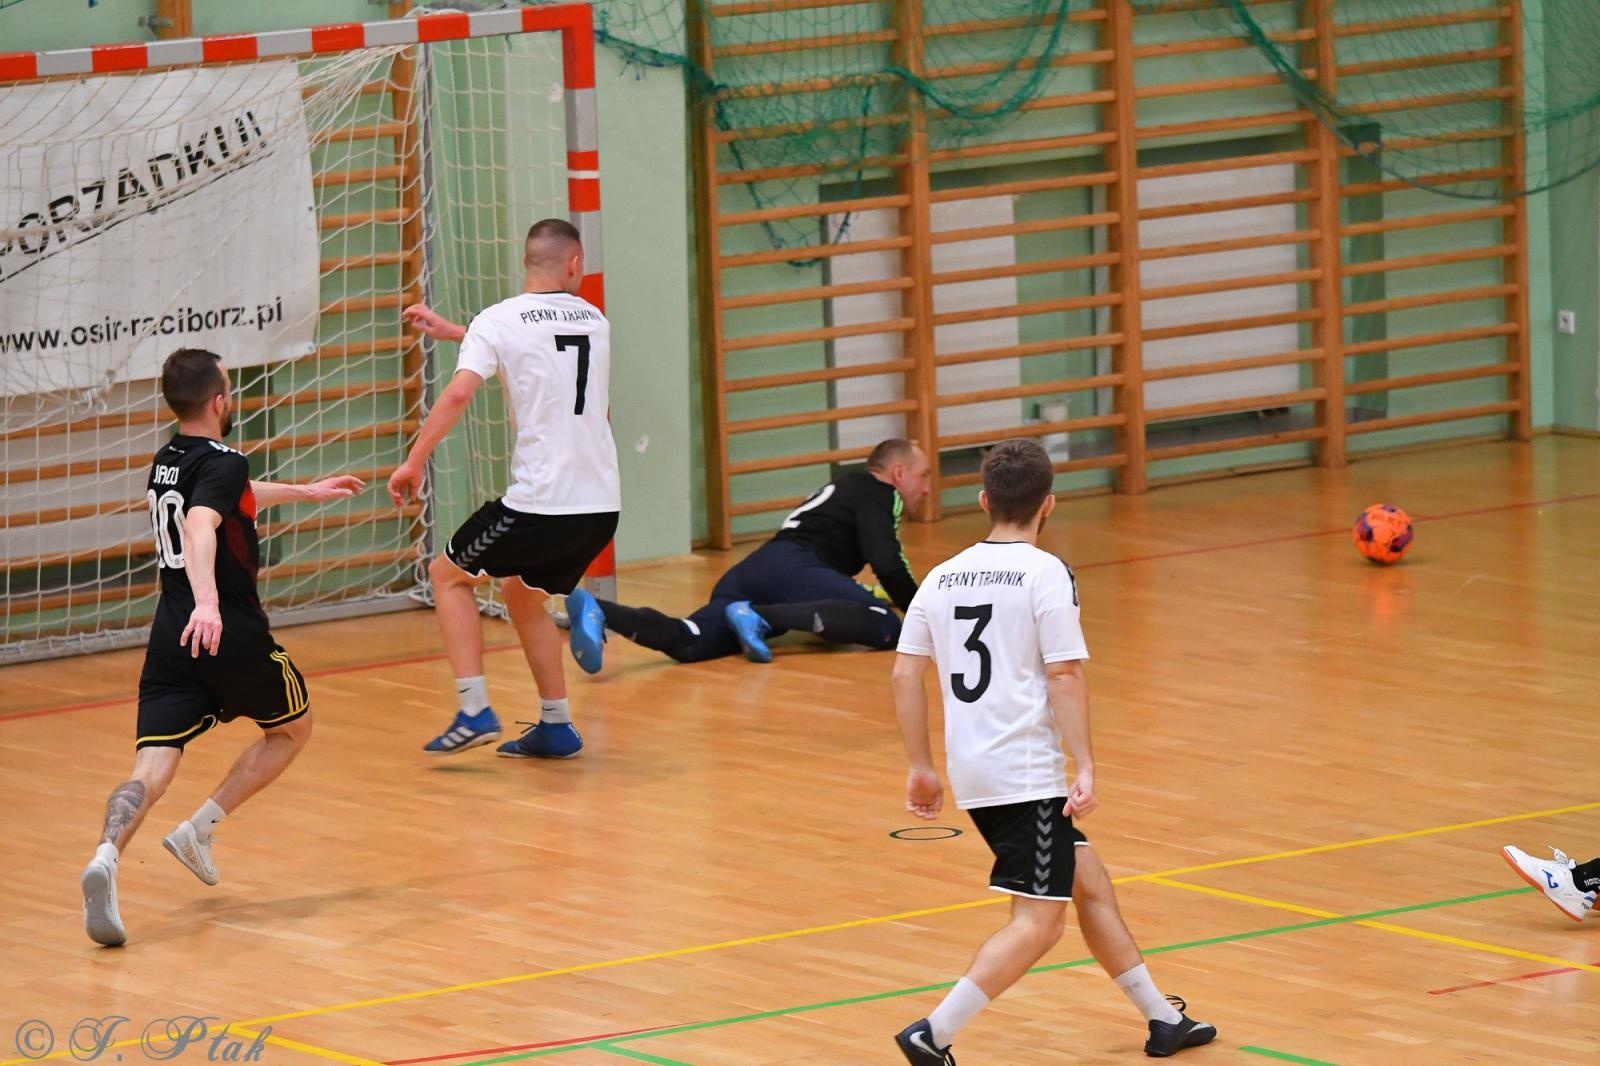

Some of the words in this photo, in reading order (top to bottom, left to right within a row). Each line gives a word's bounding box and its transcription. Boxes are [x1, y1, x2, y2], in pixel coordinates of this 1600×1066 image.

[520, 308, 558, 325] PIĘKNY
[554, 334, 591, 415] 7
[938, 571, 978, 591] PIĘKNY
[979, 570, 1026, 588] TRAWNIK
[951, 604, 993, 703] 3
